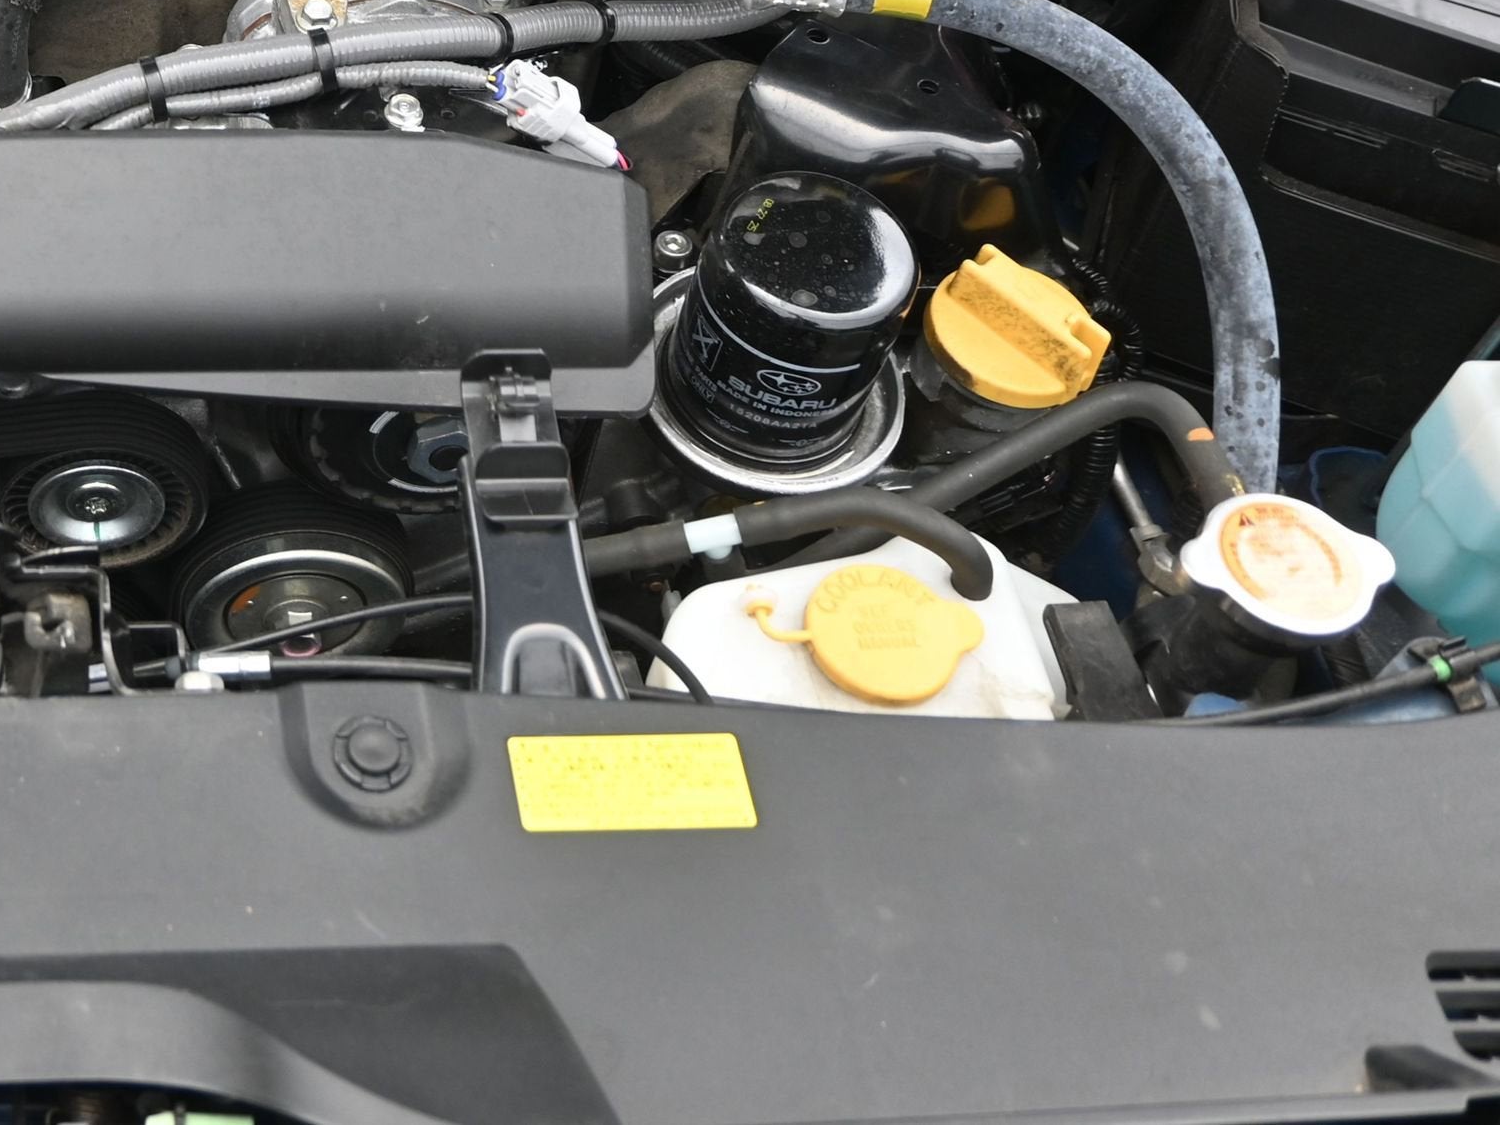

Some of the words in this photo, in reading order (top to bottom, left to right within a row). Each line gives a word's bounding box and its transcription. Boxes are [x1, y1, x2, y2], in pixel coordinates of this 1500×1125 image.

[716, 379, 750, 404] MADE
[752, 401, 767, 411] IN
[727, 375, 837, 410] SUBARU
[816, 570, 937, 614] COOLANT
